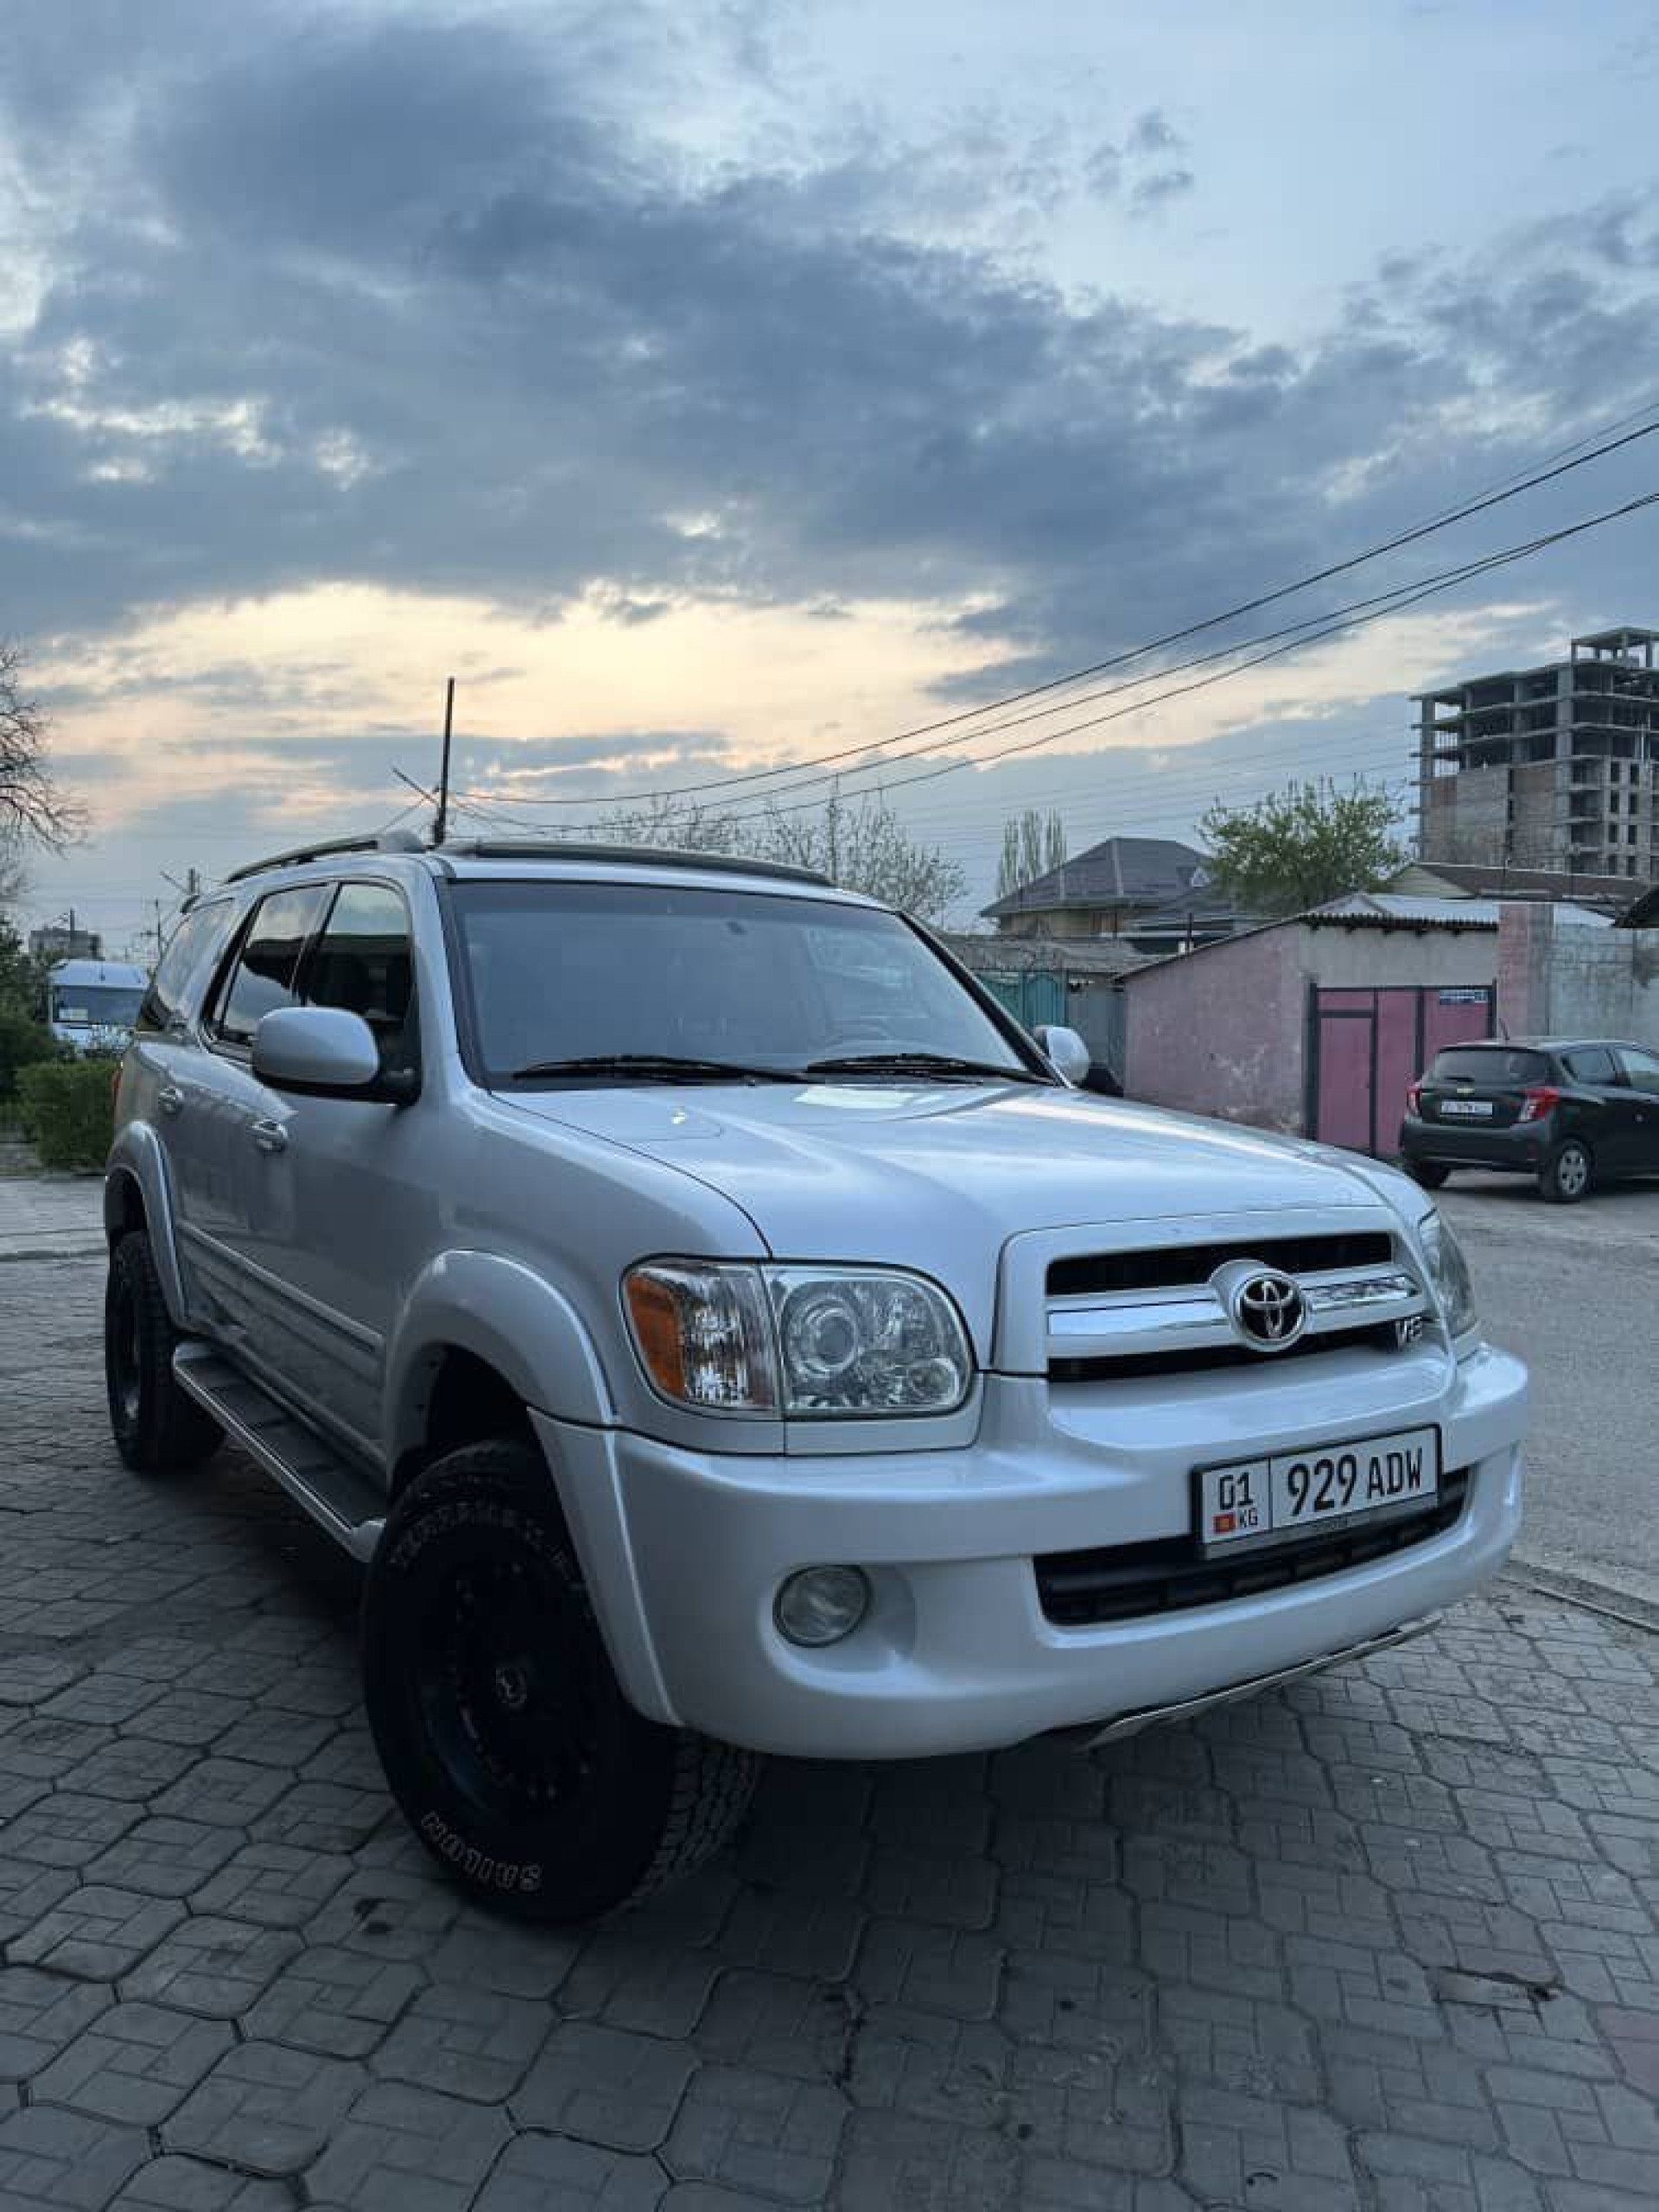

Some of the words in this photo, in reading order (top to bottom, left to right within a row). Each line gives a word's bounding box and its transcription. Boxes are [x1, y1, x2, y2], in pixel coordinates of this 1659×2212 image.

[1218, 1472, 1254, 1510] 01
[1288, 1454, 1357, 1516] 929
[1367, 1448, 1423, 1498] ADW
[1238, 1508, 1258, 1528] KG
